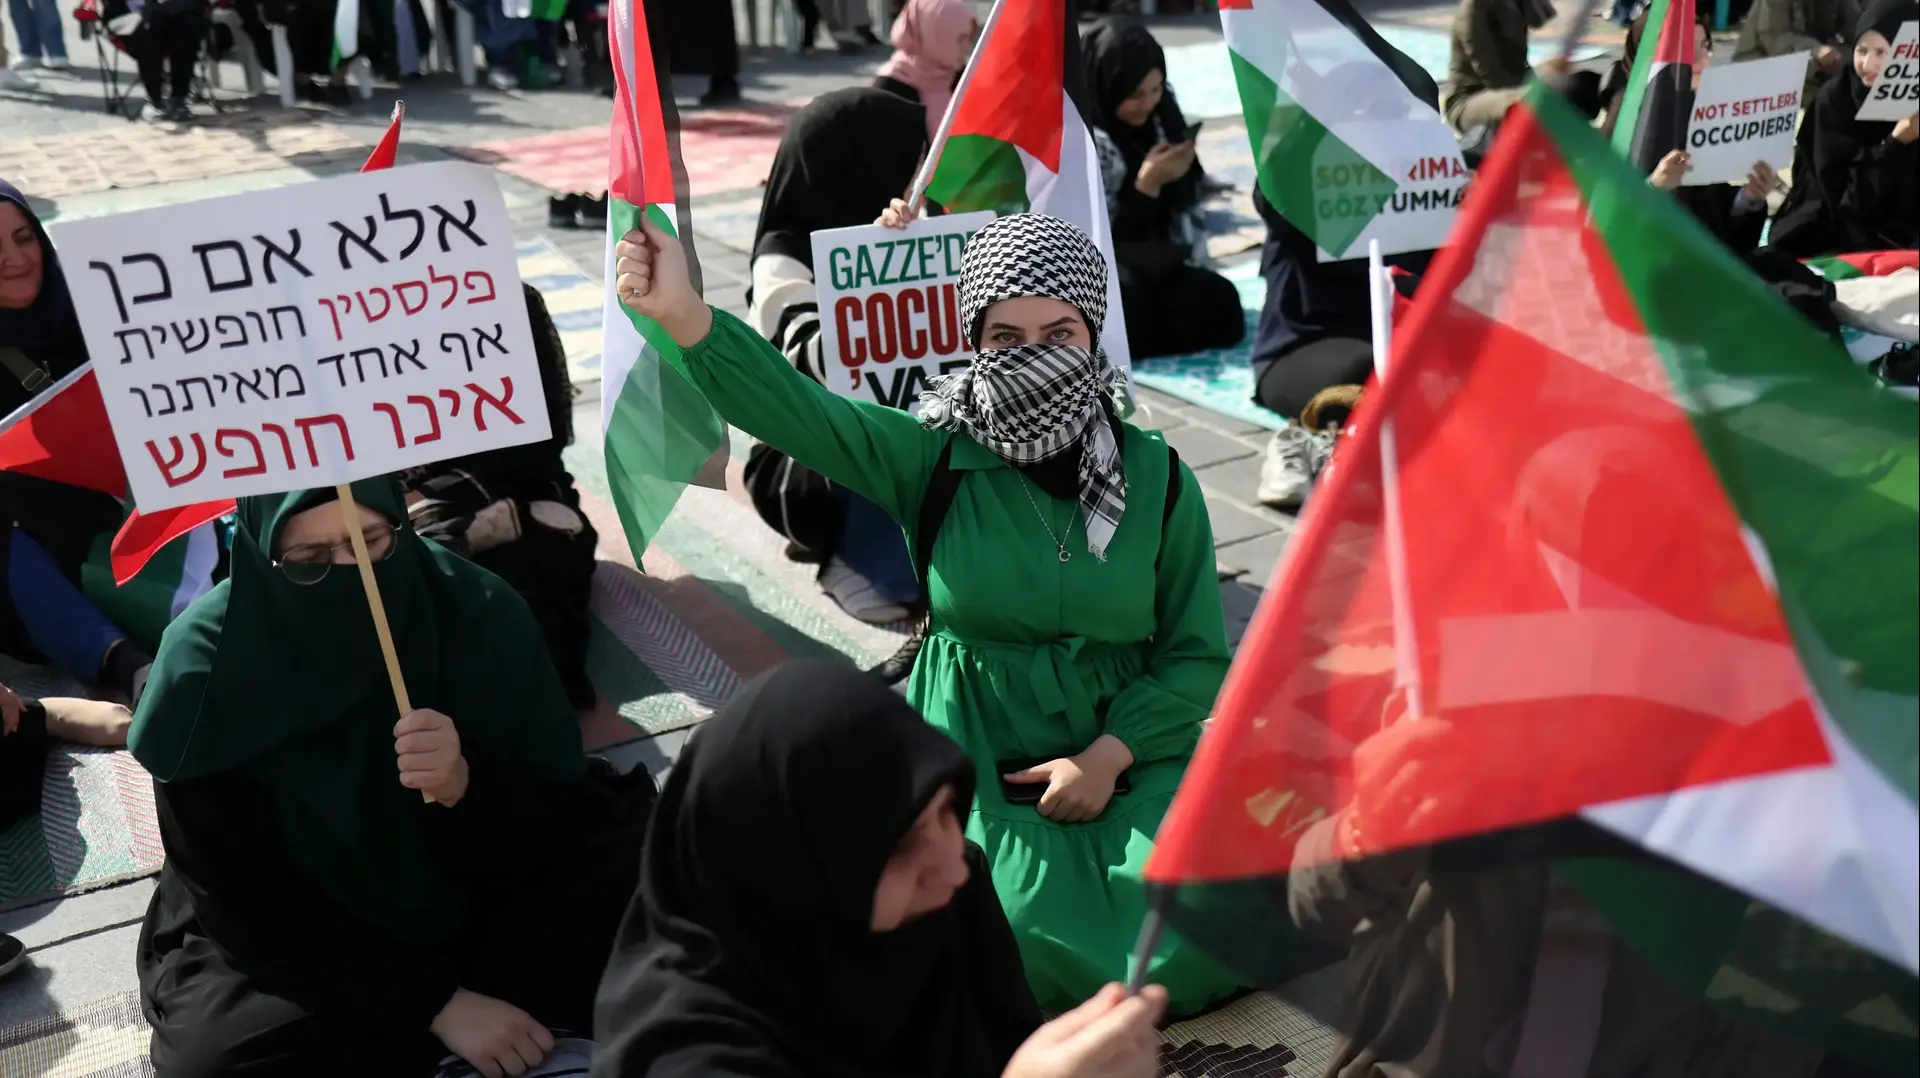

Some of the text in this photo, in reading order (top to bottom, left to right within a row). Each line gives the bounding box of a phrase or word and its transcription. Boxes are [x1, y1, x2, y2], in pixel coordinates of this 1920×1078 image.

[1884, 63, 1919, 79] OL
[1691, 112, 1797, 148] OCCUPIERS!
[1694, 103, 1728, 121] NOT
[1318, 192, 1369, 220] GÖZ
[89, 193, 488, 325] אלא אם כן
[829, 231, 978, 291] GAZZE'D
[113, 265, 497, 365] פלסטין חופשית
[834, 283, 972, 390] ÇOCU
[129, 322, 511, 419] אף אחד מאיתנו
[864, 359, 972, 412] VA
[144, 376, 526, 489] אינו חופש
